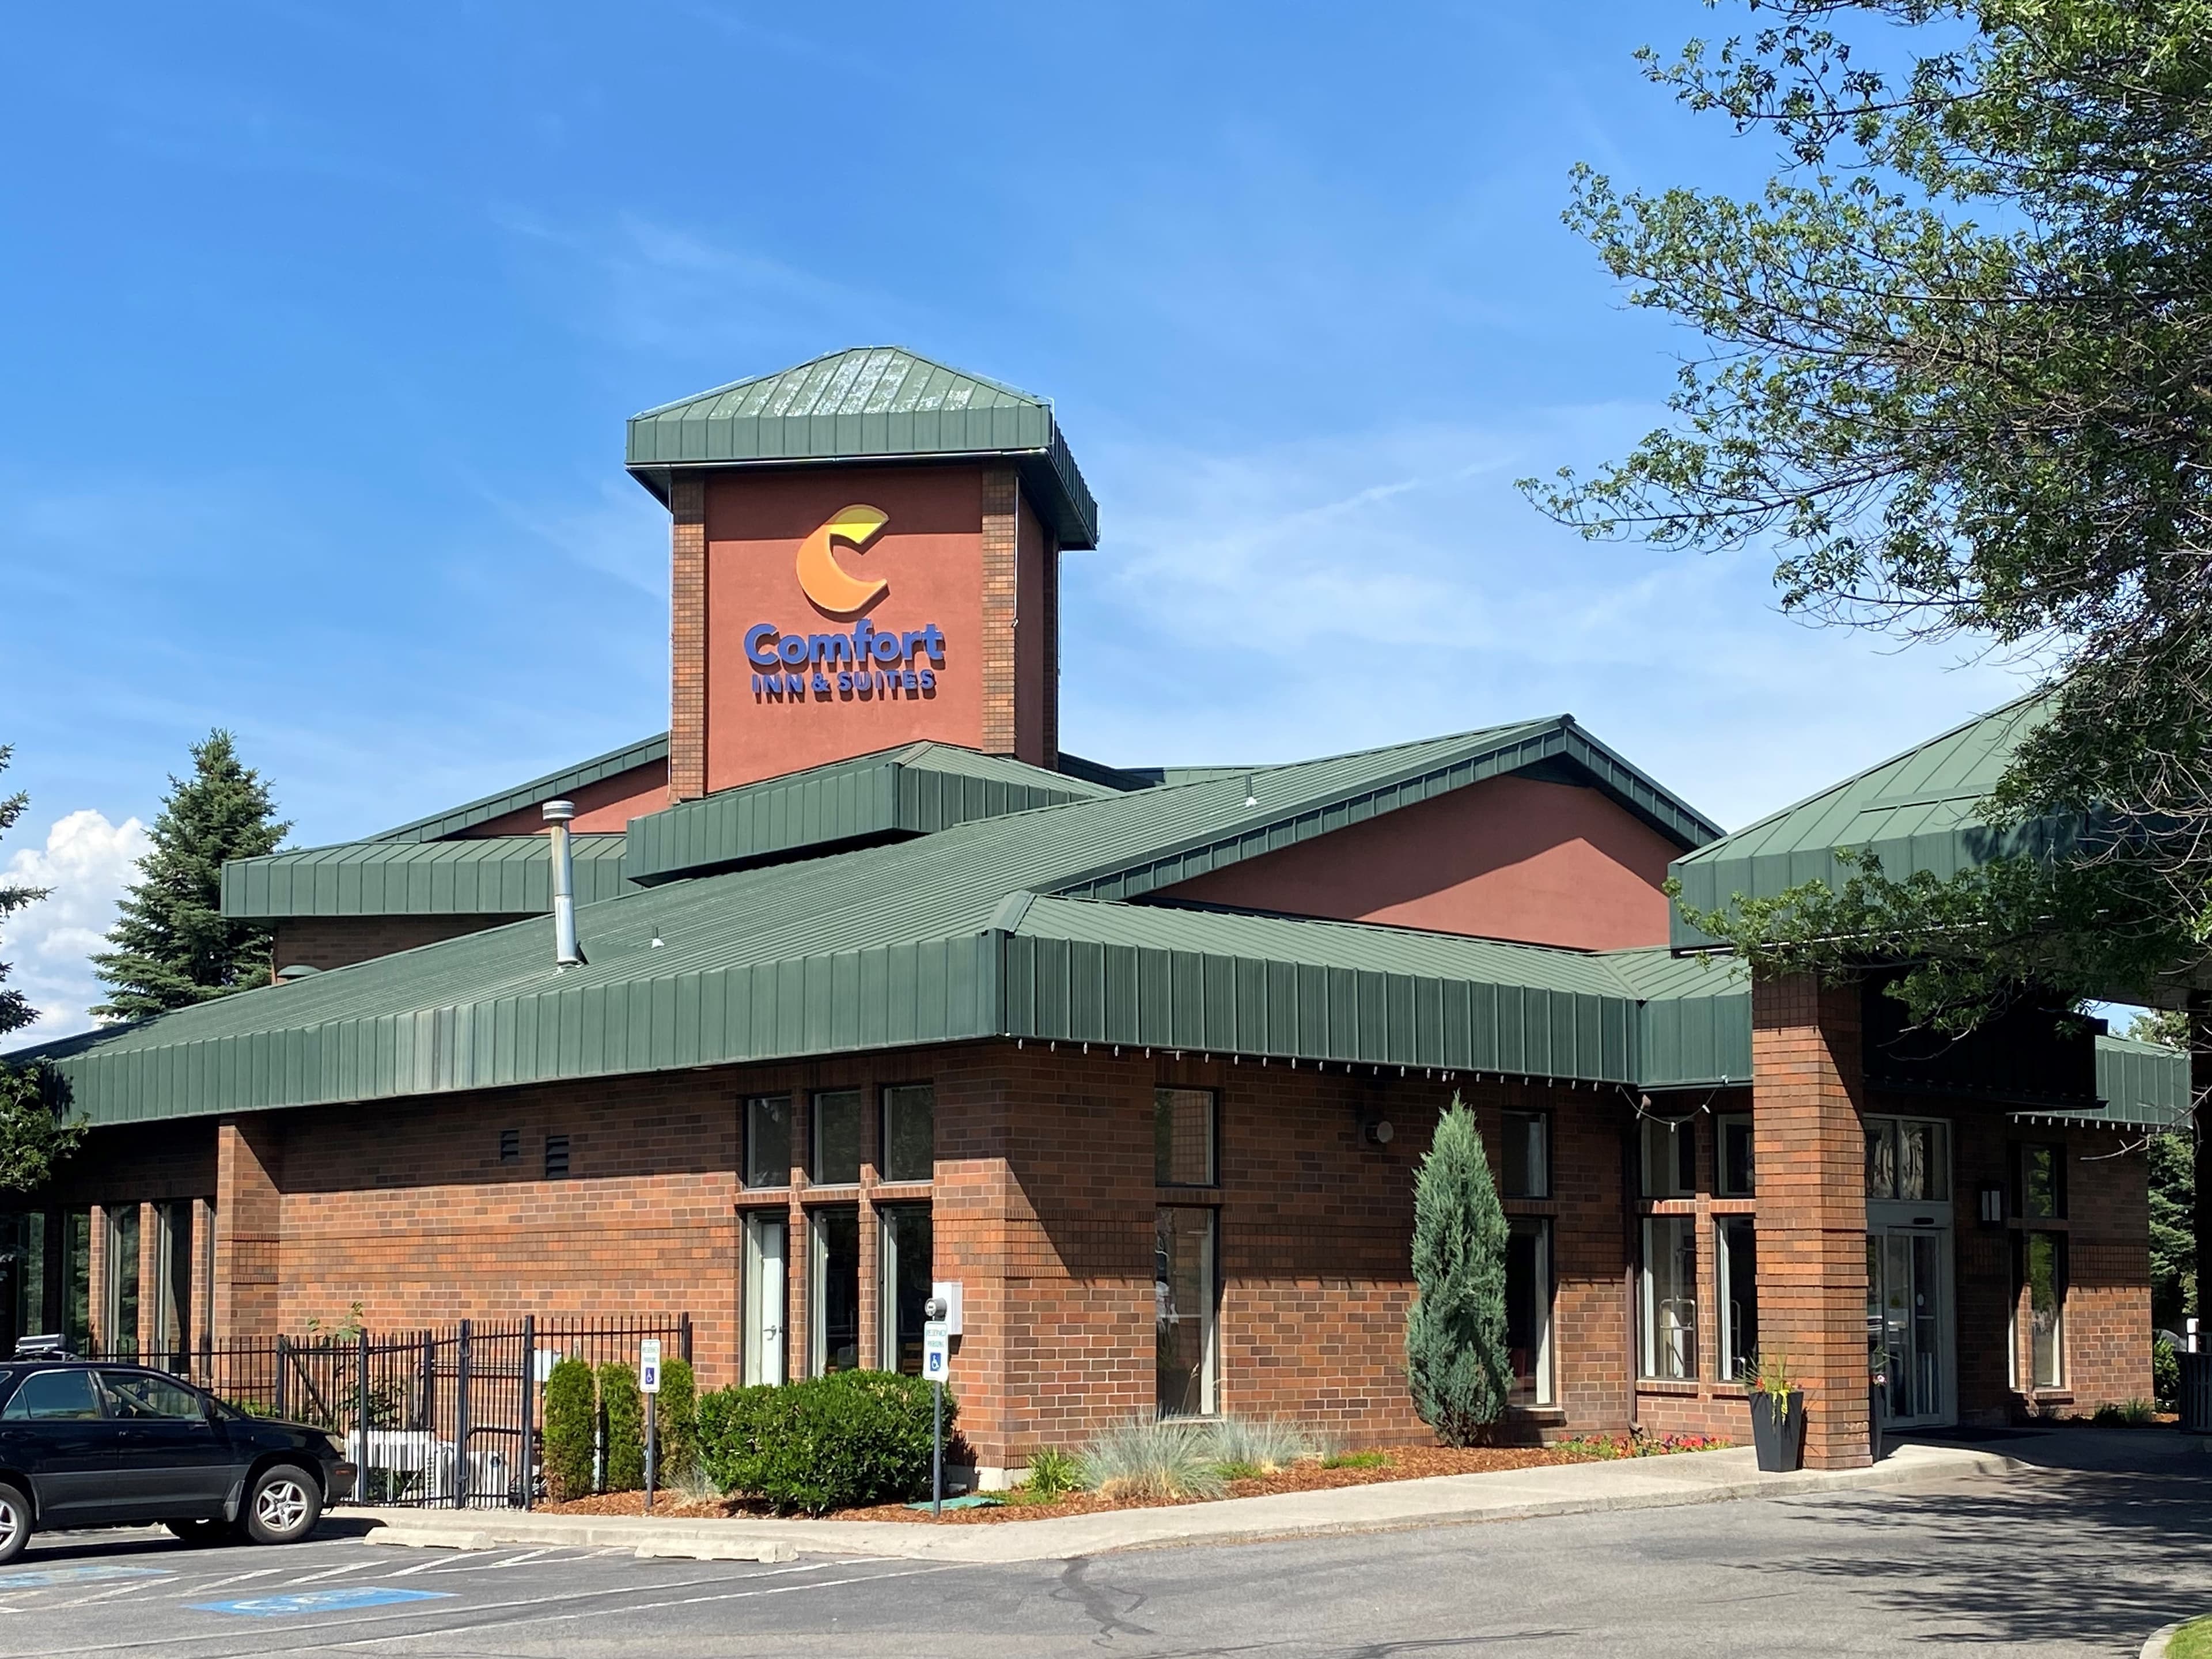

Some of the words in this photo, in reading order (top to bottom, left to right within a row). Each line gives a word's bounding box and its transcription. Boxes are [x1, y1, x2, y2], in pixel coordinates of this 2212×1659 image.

[744, 618, 945, 666] Comfort
[752, 673, 804, 694] INN
[811, 673, 830, 692] &
[836, 669, 935, 692] SUITES
